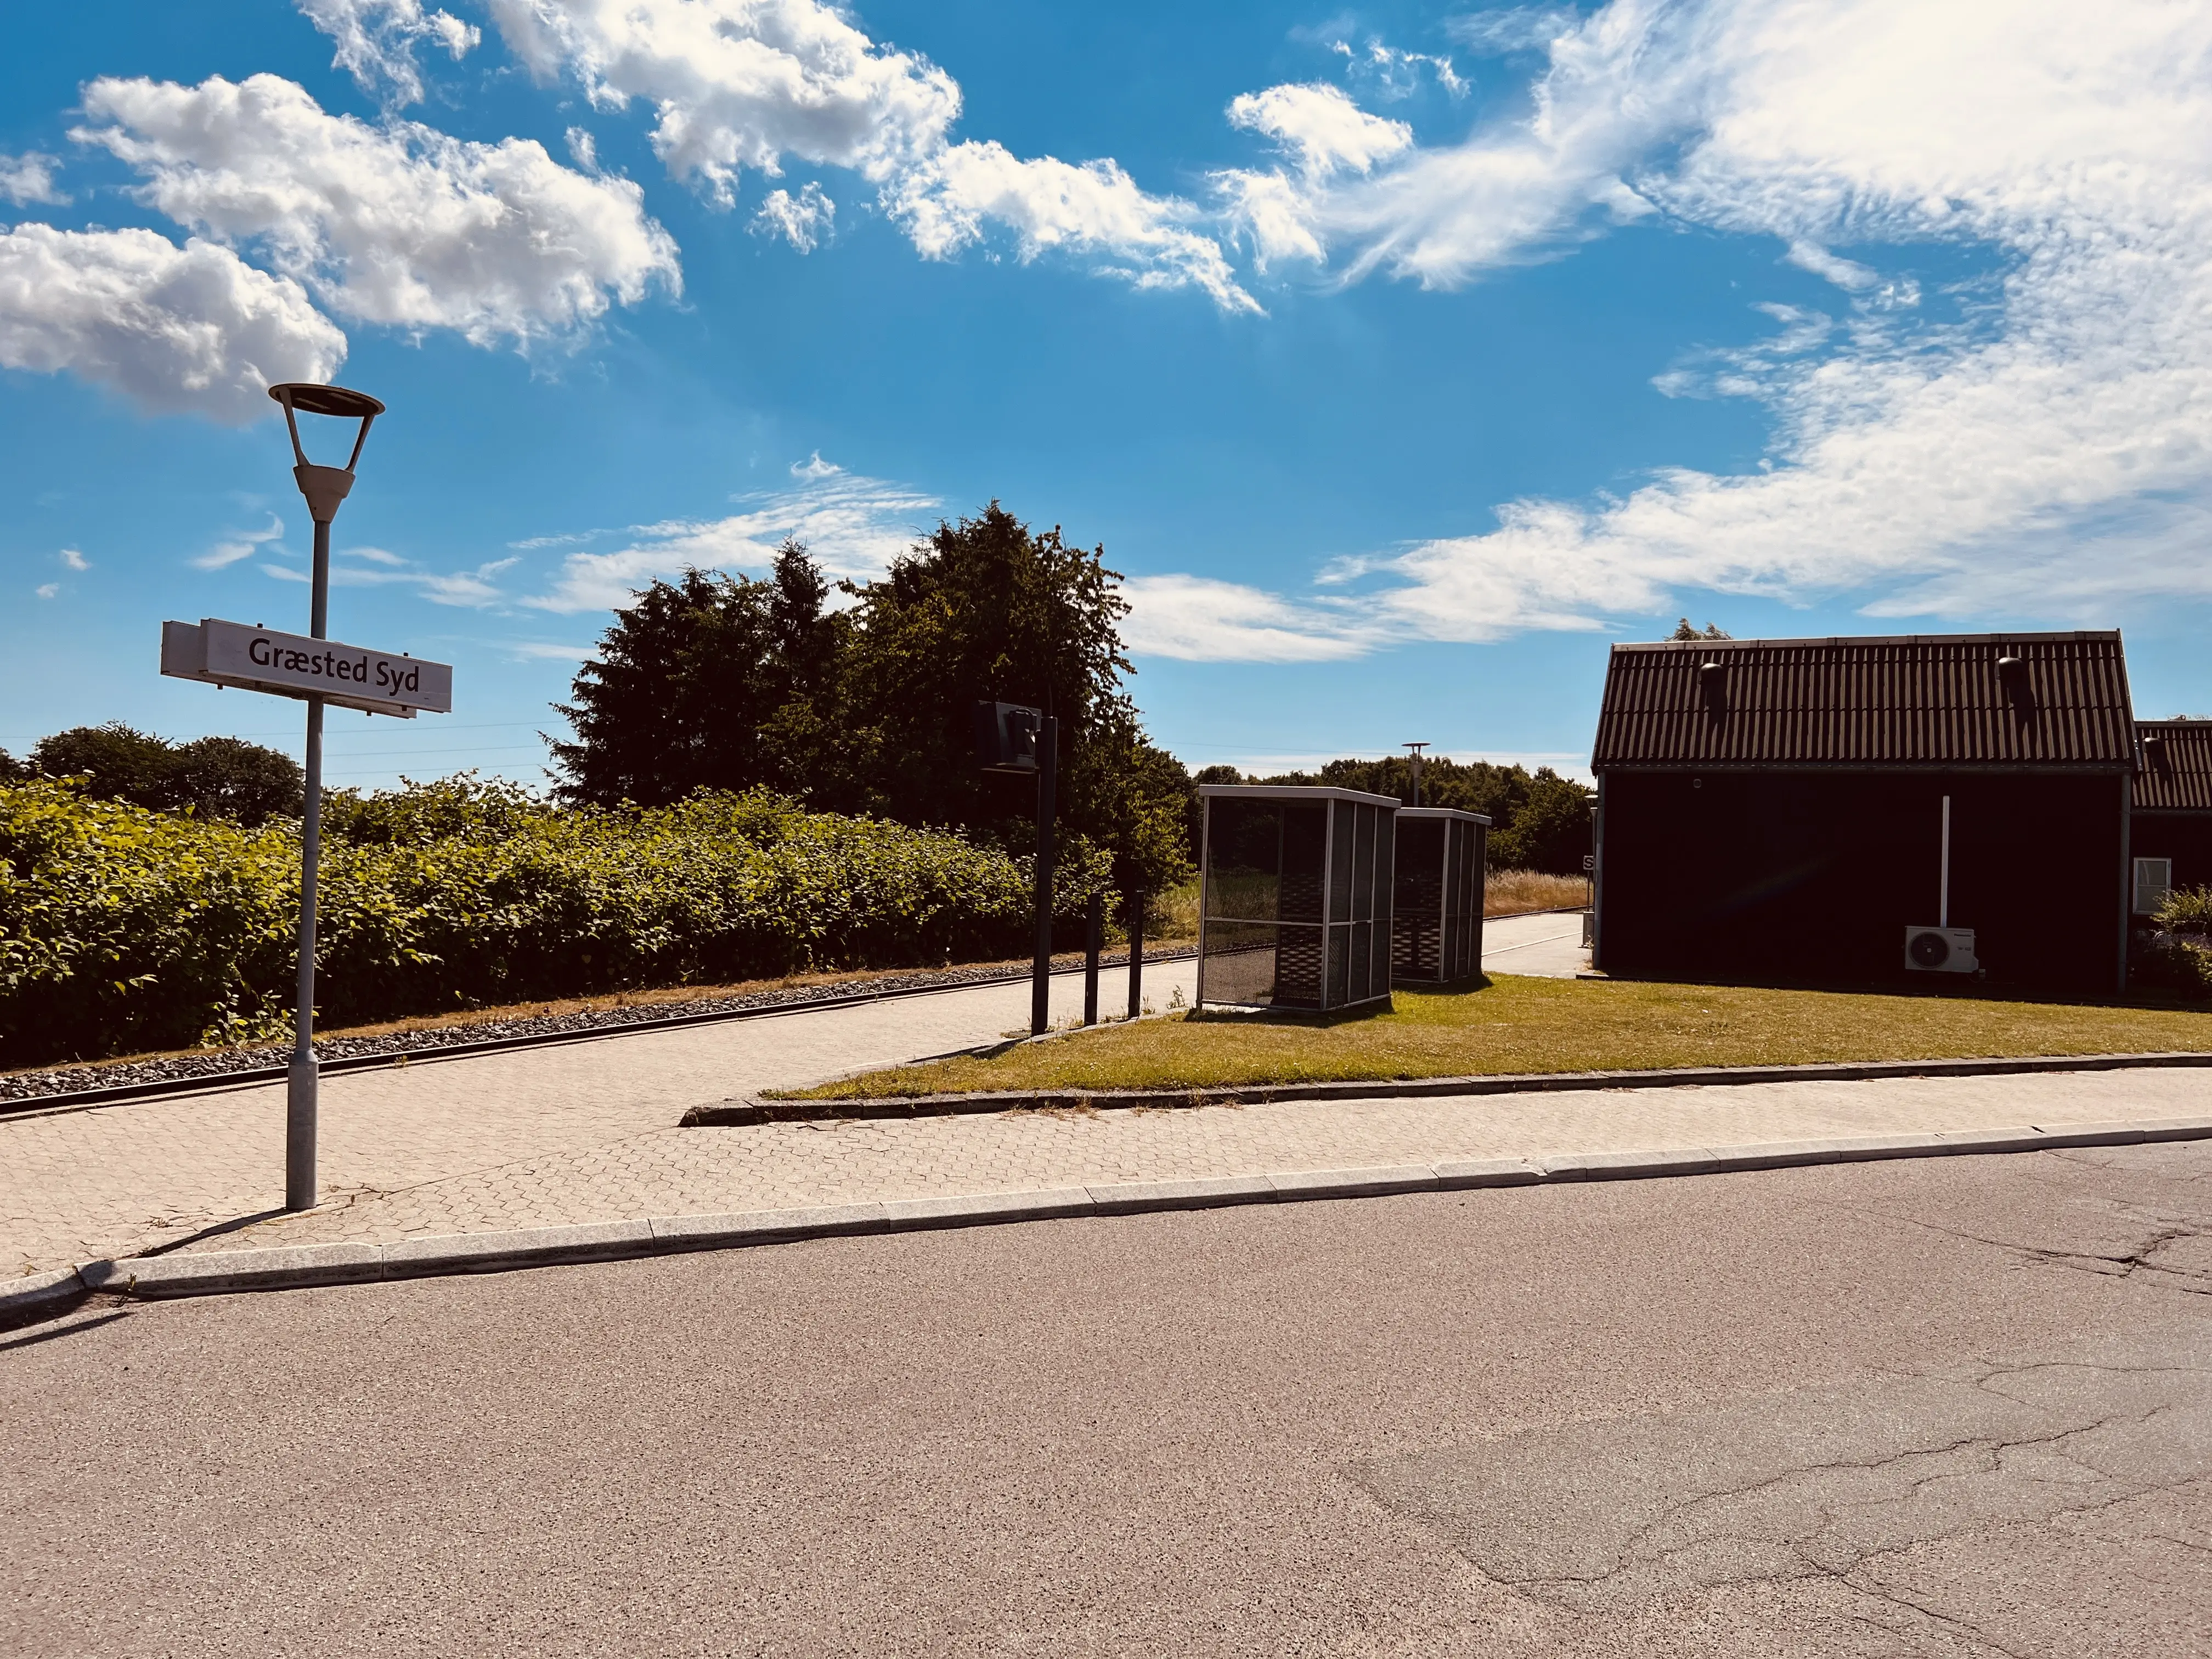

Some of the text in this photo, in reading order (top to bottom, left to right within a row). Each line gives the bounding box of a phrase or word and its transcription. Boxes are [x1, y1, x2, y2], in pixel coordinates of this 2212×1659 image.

[249, 638, 419, 697] Græsted Syd
[1584, 857, 1593, 868] S
